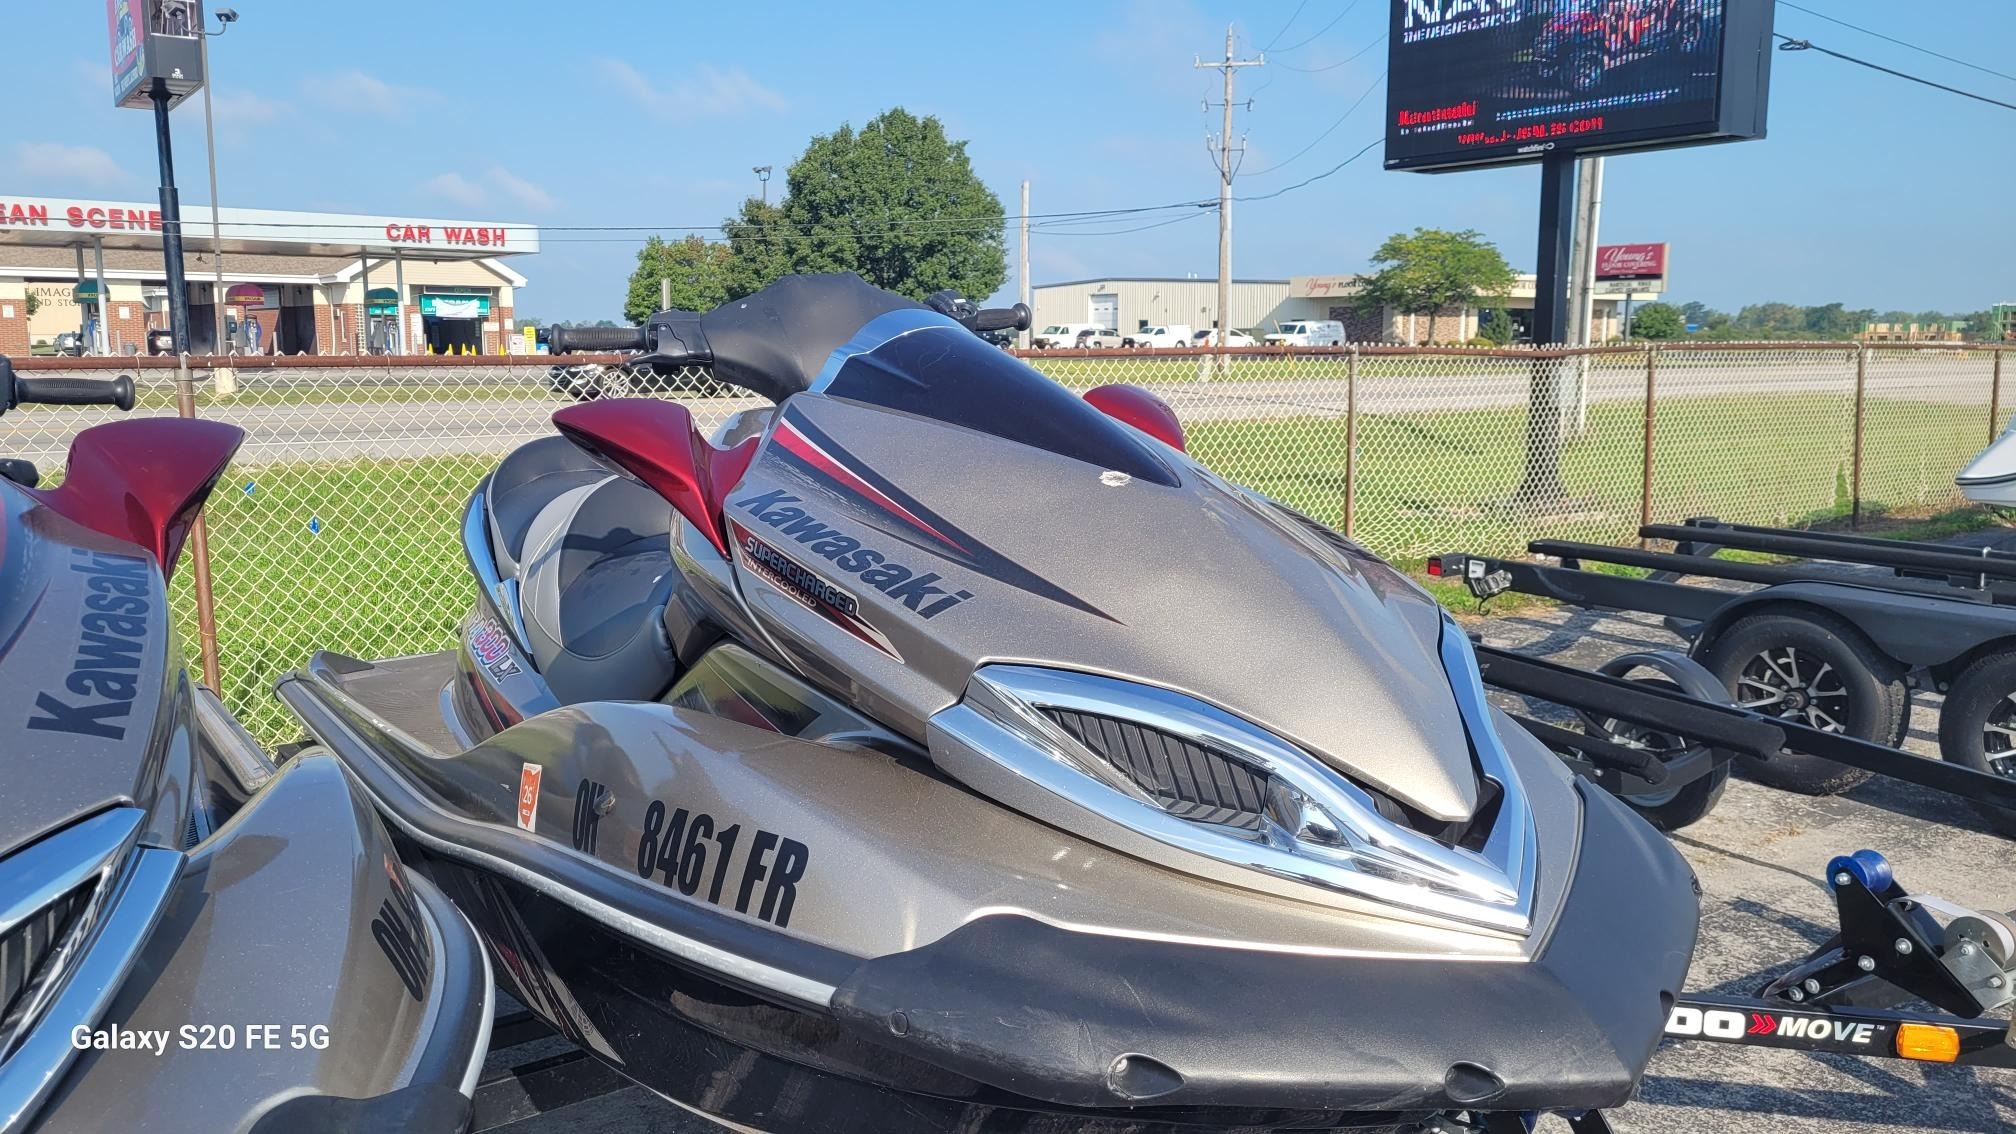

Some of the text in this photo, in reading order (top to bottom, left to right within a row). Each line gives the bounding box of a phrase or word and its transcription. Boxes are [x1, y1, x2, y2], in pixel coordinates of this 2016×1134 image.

[66, 206, 162, 231] SCENE
[386, 223, 506, 247] CAR WASH
[36, 287, 71, 297] IMAG
[36, 298, 52, 307] ND
[736, 488, 975, 620] Kawasaki
[745, 536, 858, 616] SUPERCHARGED
[747, 558, 817, 607] INTERCOOLED
[27, 547, 150, 741] Kawasaki
[523, 784, 533, 805] 26
[637, 799, 741, 905] 8461
[735, 829, 809, 929] FR
[1776, 1016, 1875, 1044] MOVE
